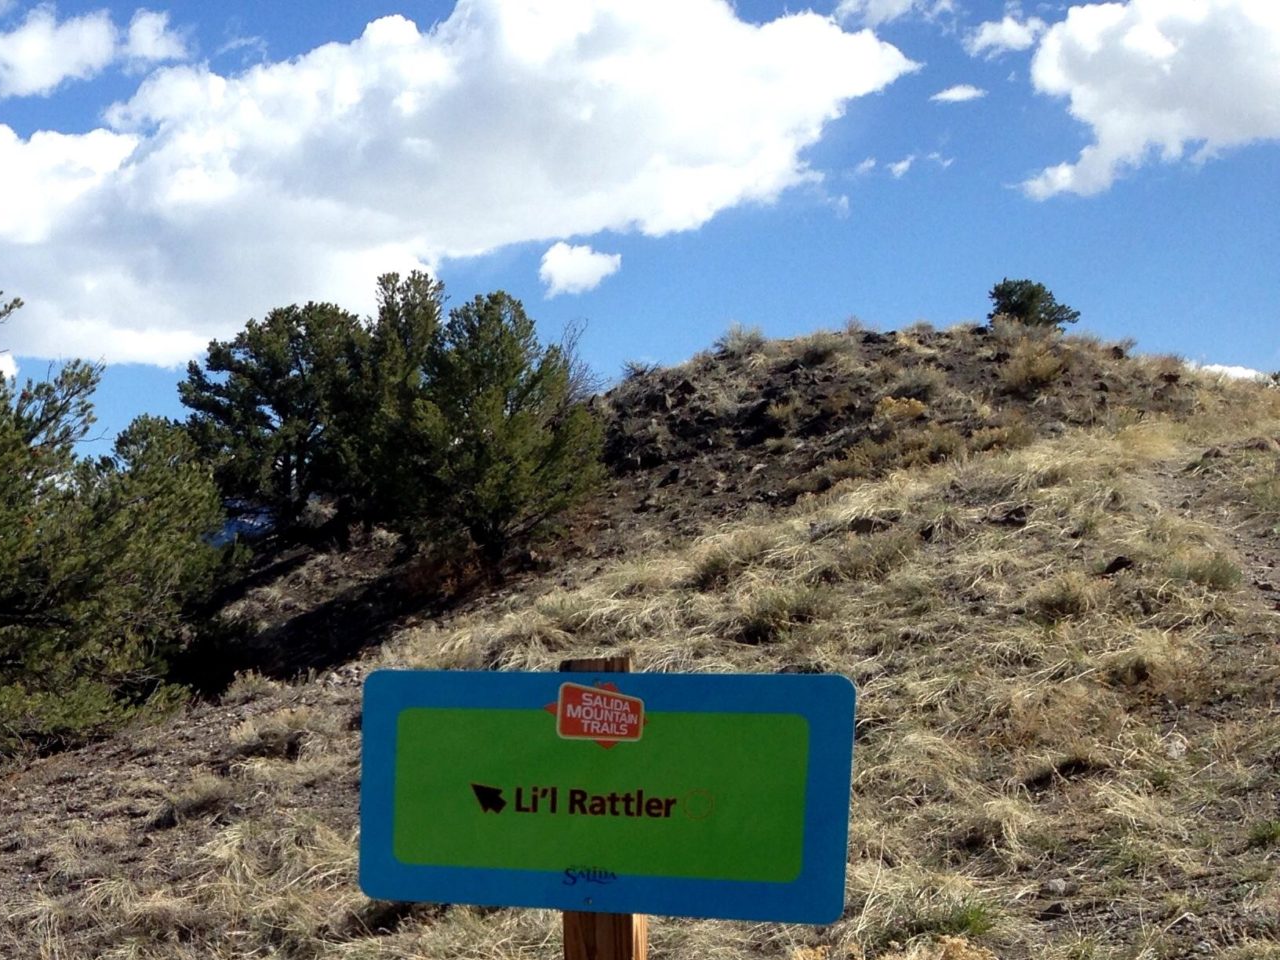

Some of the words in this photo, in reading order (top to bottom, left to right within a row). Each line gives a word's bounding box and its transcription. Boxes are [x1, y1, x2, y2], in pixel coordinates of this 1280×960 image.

[582, 693, 631, 712] SALIDA
[566, 704, 638, 725] MOUNTAIN
[581, 720, 629, 735] TRAILS
[568, 789, 677, 818] Rattler
